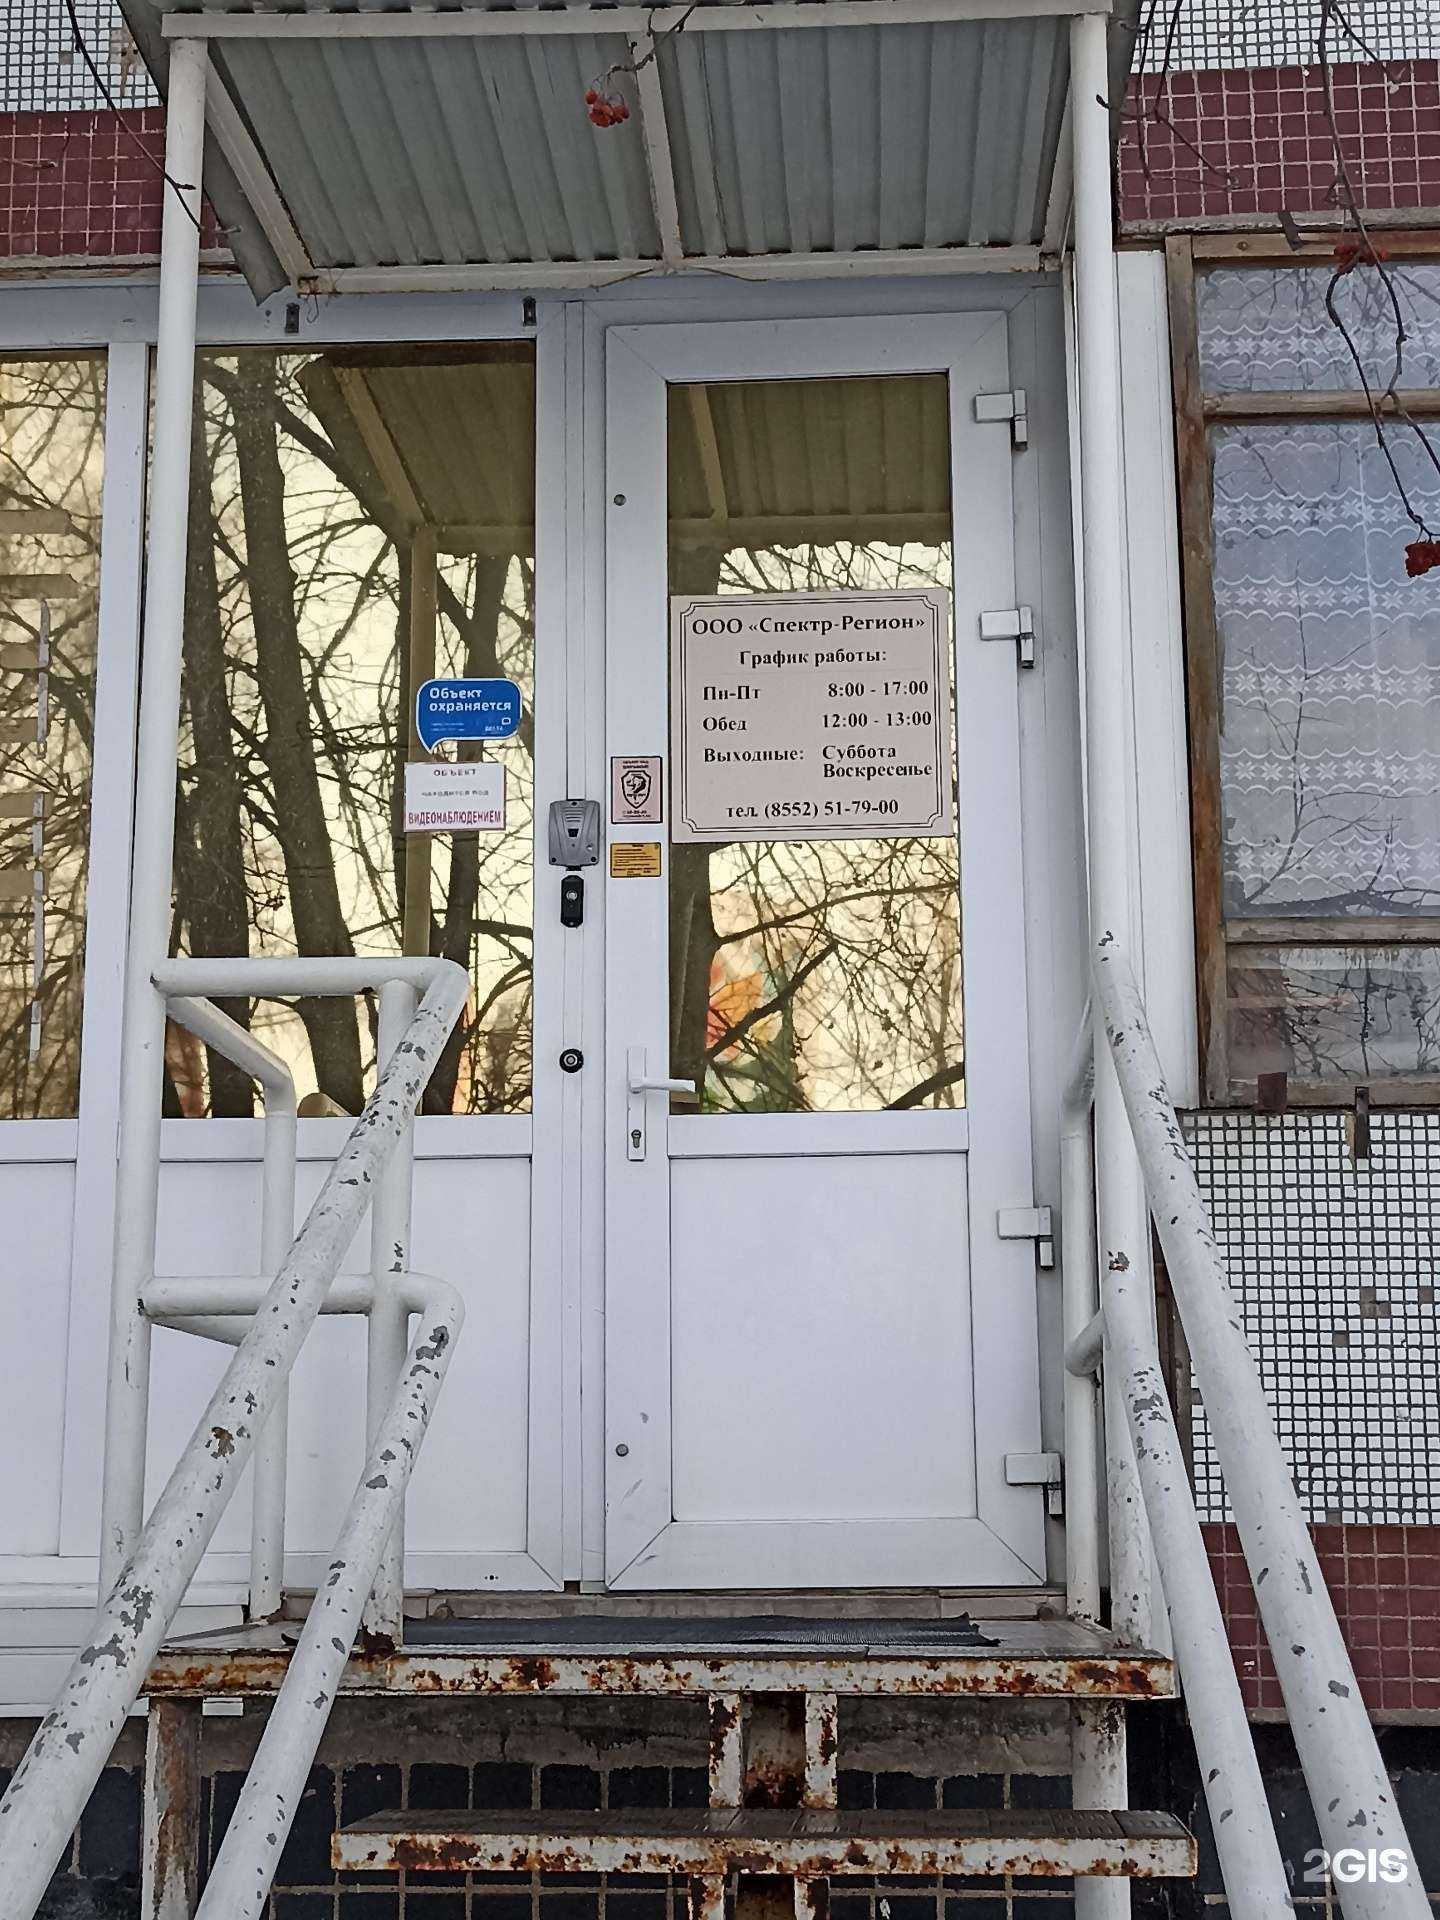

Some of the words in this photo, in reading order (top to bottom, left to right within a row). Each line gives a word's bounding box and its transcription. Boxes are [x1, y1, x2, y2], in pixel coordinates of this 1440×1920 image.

[692, 618, 743, 635] ООО
[749, 615, 925, 636] «Спектр-Регион»
[740, 651, 808, 668] График
[814, 649, 886, 667] работы:
[429, 687, 482, 699] Объект
[703, 685, 761, 701] Пн-Пт
[828, 682, 865, 698] 8:00
[883, 681, 928, 697] 17:00
[429, 701, 511, 714] охраняется
[703, 716, 747, 731] Обед
[823, 713, 868, 728] 12:00
[887, 711, 932, 727] 13:00
[704, 748, 804, 763] Выходные:
[822, 745, 896, 763] Суббота
[823, 763, 932, 781] Воскресенье
[408, 810, 501, 826] ВИДЕОНАБЛЮДЕНИЕМ
[727, 805, 758, 819] тел.
[764, 802, 819, 818] (8552)
[824, 800, 899, 816] 51-79-00
